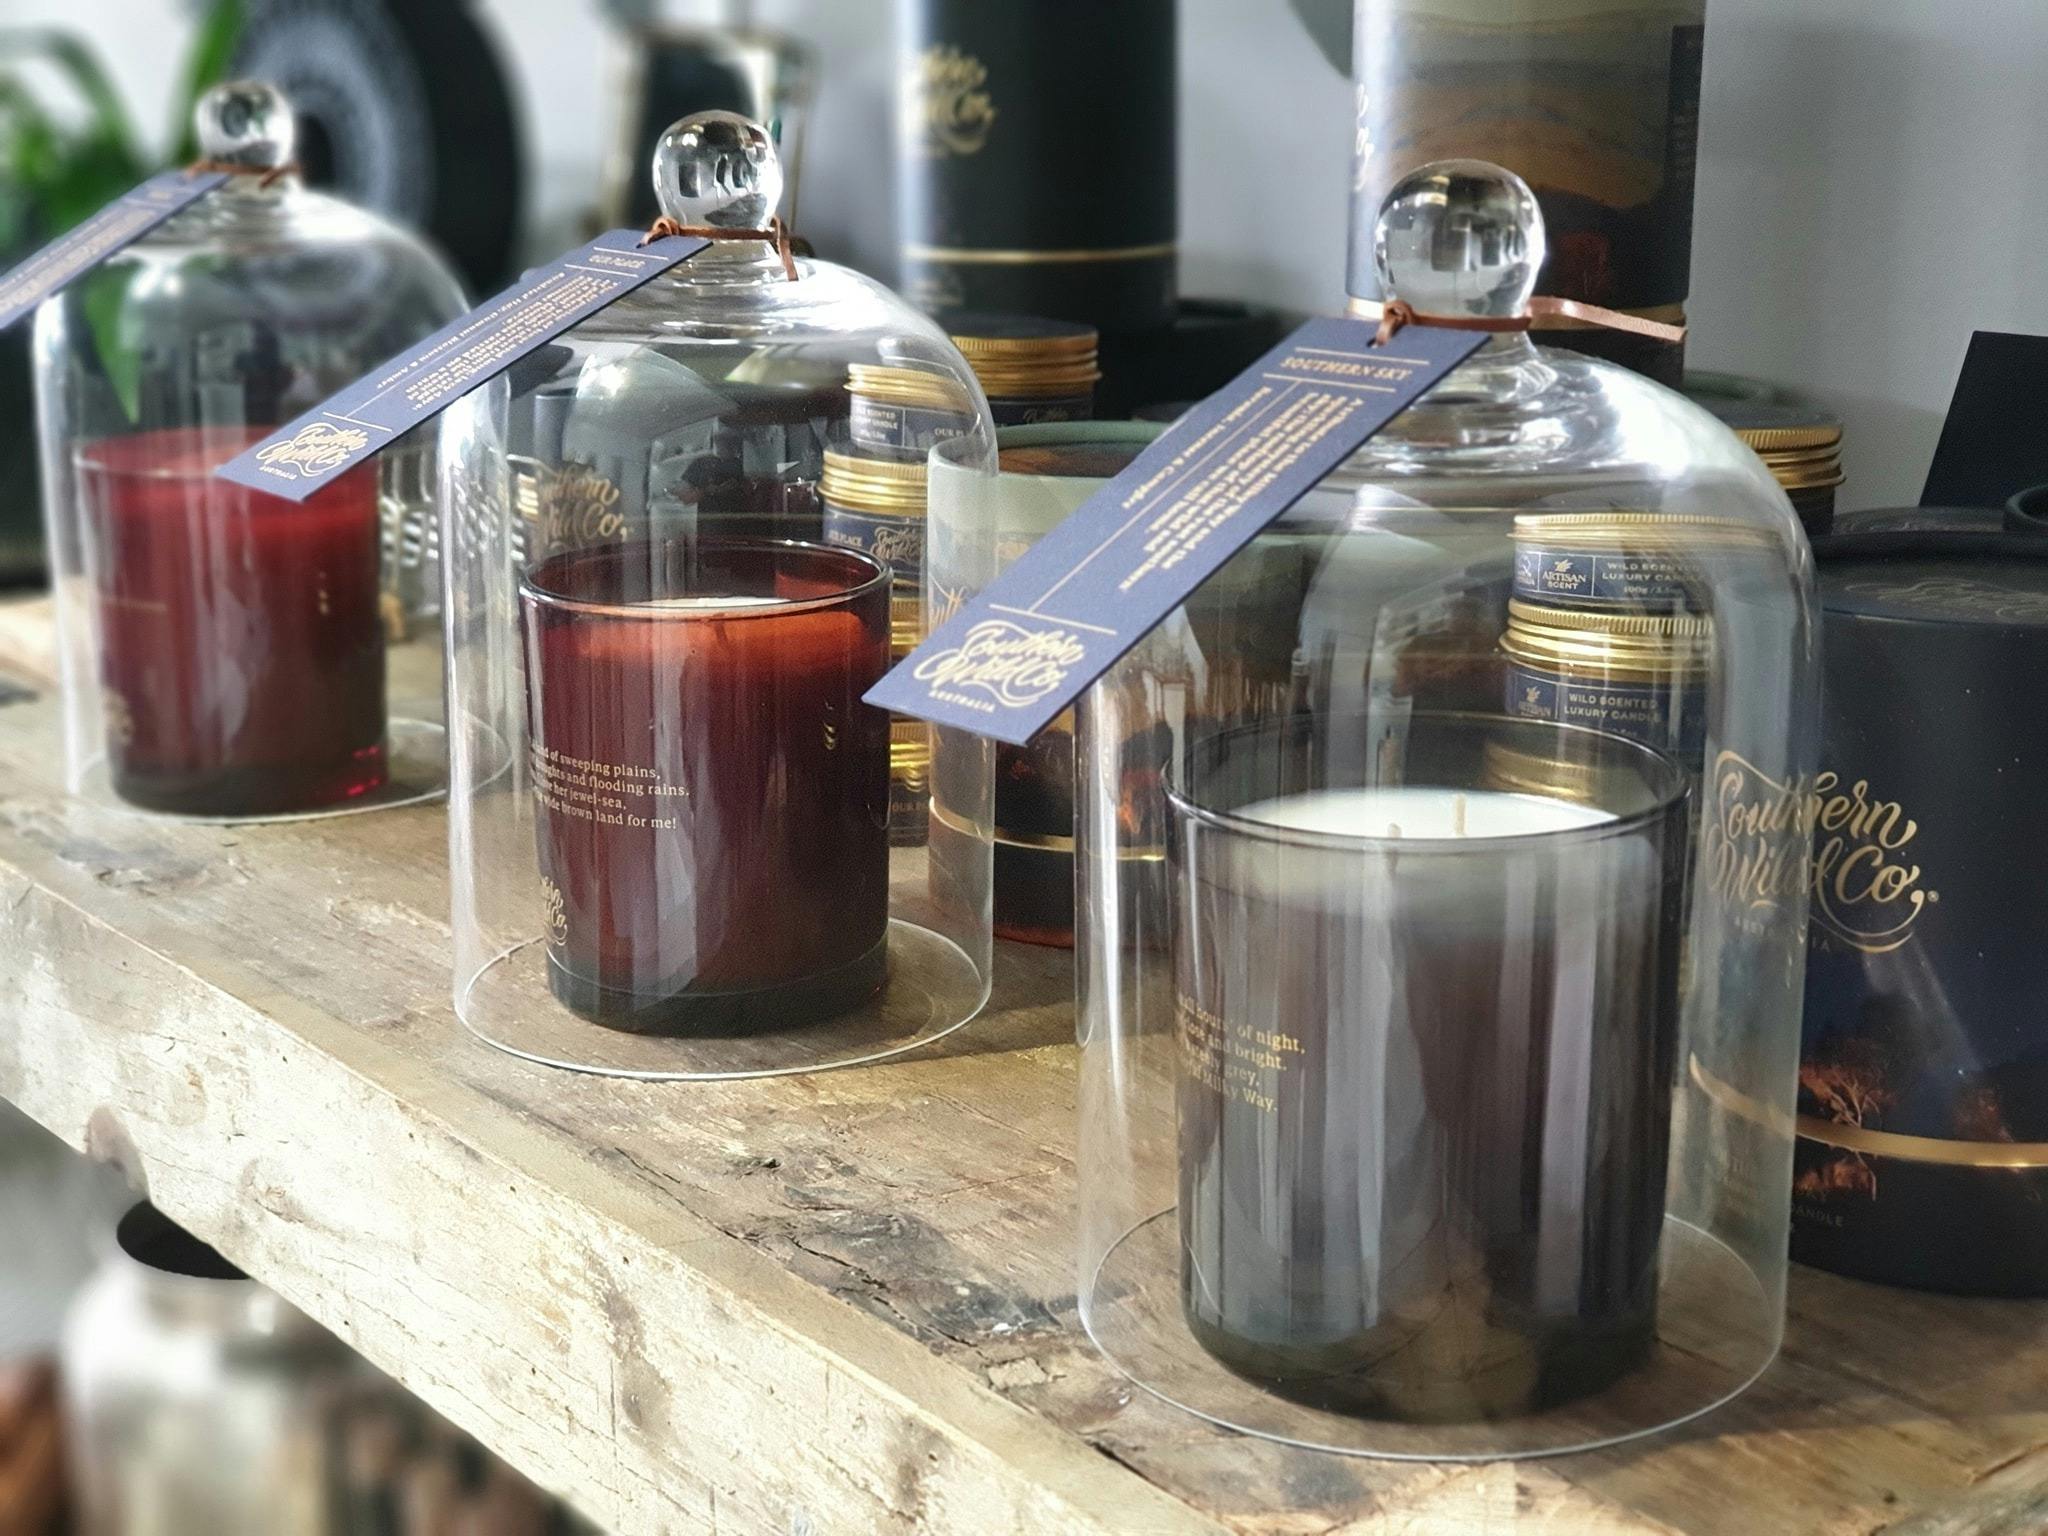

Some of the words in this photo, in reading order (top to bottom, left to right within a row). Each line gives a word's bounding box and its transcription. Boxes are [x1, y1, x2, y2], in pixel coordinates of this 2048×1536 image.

[1279, 355, 1375, 380] SOUTHERN
[1373, 367, 1412, 384] SKY
[1303, 405, 1357, 442] tribute
[1220, 436, 1264, 465] place
[1289, 441, 1315, 454] to
[1169, 457, 1189, 466] &
[1204, 464, 1230, 480] we
[1231, 442, 1293, 486] mystery
[1267, 453, 1301, 472] the
[1218, 469, 1244, 483] of
[1229, 471, 1280, 503] Milky
[1179, 479, 1214, 501] call
[1193, 481, 1230, 505] that
[1218, 484, 1245, 498] of
[1164, 503, 1205, 530] wild
[1198, 497, 1231, 517] the
[1202, 502, 1243, 528] Way
[1172, 515, 1209, 540] vast
[1178, 526, 1216, 550] and
[1139, 528, 1176, 552] and
[1112, 538, 1184, 592] southern
[1156, 549, 1191, 571] the
[1607, 562, 1639, 571] WILD
[1542, 570, 1587, 583] ARTISAN
[1547, 581, 1579, 591] SCENT
[1602, 572, 1651, 582] LUXURY
[964, 620, 1085, 666] Southern
[928, 689, 996, 714] AUSTRALIA
[1569, 693, 1597, 705] WILD
[1600, 695, 1659, 711] SCENTED
[1564, 706, 1609, 719] LUXURY
[1611, 711, 1662, 723] CANDLE
[550, 749, 560, 762] of
[560, 753, 610, 777] sweeping
[613, 763, 661, 781] plains,
[553, 781, 568, 797] her
[566, 773, 587, 786] and
[589, 775, 644, 797] flooding
[561, 800, 593, 820] brown
[596, 809, 624, 825] land
[627, 814, 647, 827] for
[651, 817, 677, 830] me!
[1237, 1024, 1252, 1040] of
[1208, 1033, 1230, 1054] and
